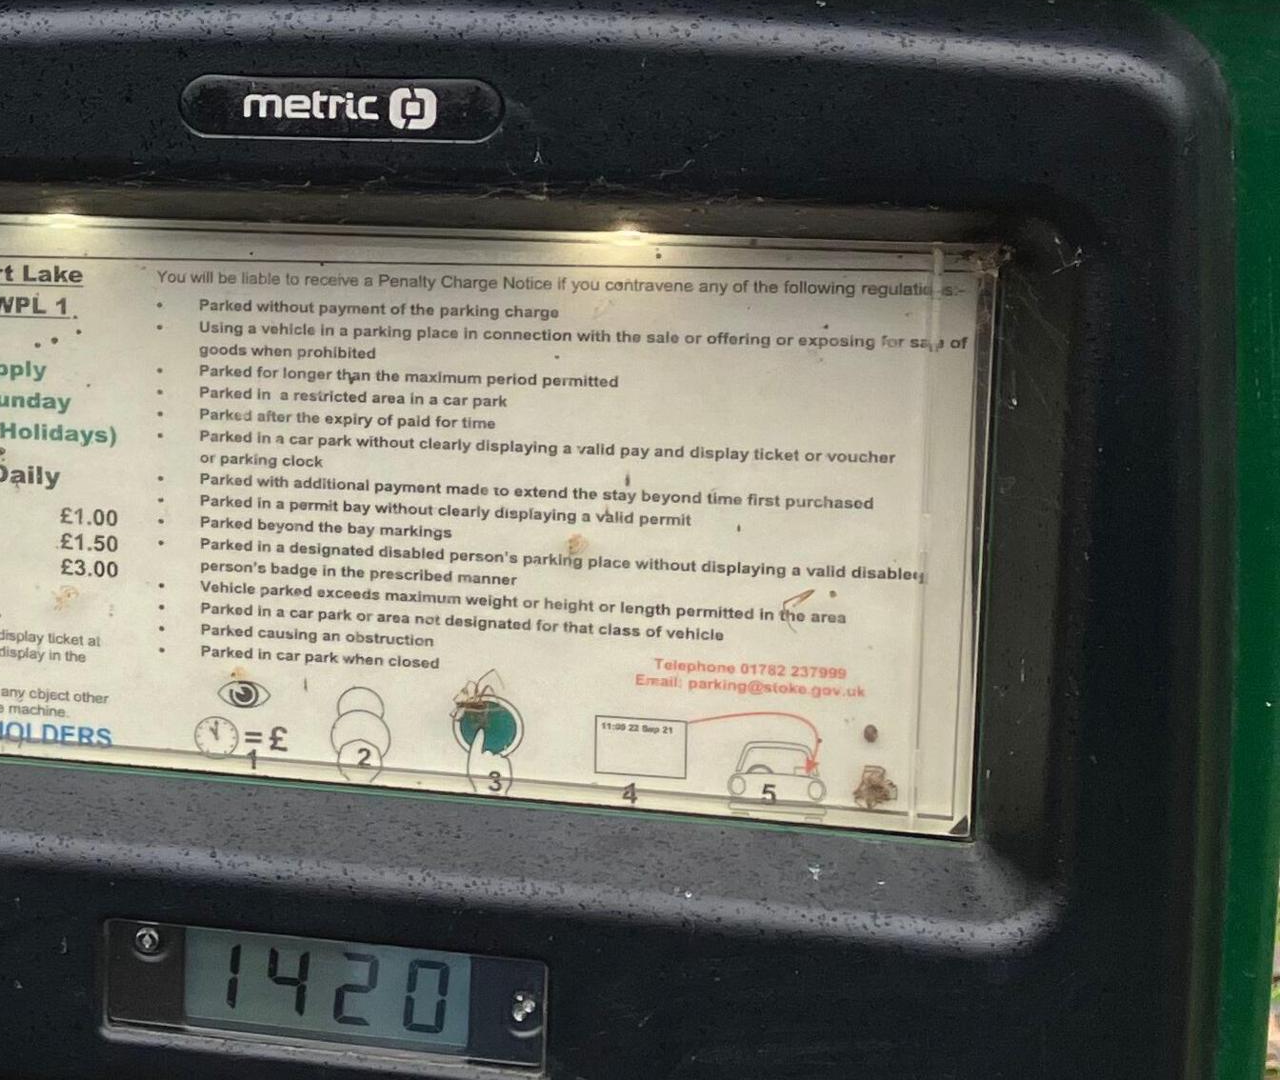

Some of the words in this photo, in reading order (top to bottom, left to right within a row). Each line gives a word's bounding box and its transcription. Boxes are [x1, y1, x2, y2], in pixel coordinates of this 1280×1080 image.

[243, 90, 379, 120] metric
[23, 265, 83, 283] Lake
[156, 271, 186, 283] You
[190, 272, 214, 283] will
[218, 272, 237, 284] be
[241, 272, 281, 285] liable
[285, 273, 300, 285] to
[304, 276, 359, 286] receive
[363, 277, 374, 287] a
[378, 274, 437, 292] Penalty
[440, 276, 499, 292] Charge
[502, 276, 553, 290] Notice
[557, 277, 567, 290] if
[571, 281, 600, 294] you
[604, 279, 694, 292] contravene
[698, 283, 729, 296] any
[732, 280, 749, 293] of
[753, 281, 779, 293] the
[784, 280, 856, 298] following
[56, 298, 68, 315] 1
[199, 299, 253, 311] Parked
[256, 301, 315, 313] without
[318, 304, 386, 316] payment
[390, 303, 406, 315] of
[409, 304, 435, 315] the
[439, 304, 500, 320] parking
[504, 305, 560, 321] charge
[198, 344, 247, 358] goods
[250, 345, 293, 357] when
[297, 346, 377, 360] prohibited
[199, 365, 253, 377] Parked
[256, 366, 278, 378] for
[282, 368, 333, 382] longer
[336, 369, 371, 385] than
[375, 370, 400, 382] the
[404, 372, 482, 384] maximum
[486, 373, 538, 387] period
[541, 376, 619, 389] permitted
[199, 408, 253, 421] Parked
[257, 410, 293, 422] after
[296, 412, 320, 424] the
[324, 414, 373, 428] expiry
[376, 414, 393, 426] of
[396, 415, 431, 429] paid
[435, 416, 458, 427] for
[461, 417, 496, 429] time
[0, 422, 118, 448] Holidays)
[199, 455, 216, 463] or
[220, 454, 278, 469] parking
[281, 455, 324, 467] clock
[199, 473, 253, 486] Parked
[256, 476, 289, 488] with
[293, 477, 370, 491] additional
[374, 483, 442, 495] payment
[445, 484, 489, 495] made
[493, 487, 510, 496] to
[513, 487, 568, 498] extend
[572, 488, 598, 500] the
[602, 490, 637, 504] stay
[641, 490, 702, 505] beyond
[706, 492, 743, 505] time
[747, 494, 781, 507] first
[785, 496, 874, 510] purchased
[60, 507, 119, 527] £1.00
[200, 516, 253, 529] Parked
[257, 519, 314, 534] beyond
[317, 521, 343, 533] the
[347, 522, 375, 538] bay
[379, 525, 453, 541] markings
[60, 533, 119, 553] £1.50
[60, 558, 119, 578] £3.00
[200, 562, 267, 573] person's
[270, 562, 318, 578] badge
[322, 565, 337, 576] in
[340, 566, 365, 578] the
[369, 569, 453, 582] prescribed
[457, 574, 518, 585] manner
[47, 633, 84, 646] ticket
[200, 624, 254, 637] Parked
[257, 629, 318, 643] causing
[322, 633, 341, 641] an
[345, 632, 435, 647] obstruction
[200, 645, 254, 659] Parked
[257, 648, 272, 660] in
[275, 652, 301, 661] car
[304, 652, 339, 665] park
[342, 654, 384, 665] when
[388, 656, 440, 669] closed
[655, 658, 735, 674] Telephone
[741, 663, 785, 676] 01782
[791, 666, 847, 679] 237999
[635, 674, 681, 688] Email:
[688, 679, 865, 698] parking@stoke.gov.uk
[8, 704, 69, 717] machine.
[247, 749, 259, 769] 1
[357, 749, 372, 767] 2
[488, 772, 503, 792] 3
[623, 783, 639, 805] 4
[762, 784, 777, 807] 5
[226, 944, 450, 1034] 1420
